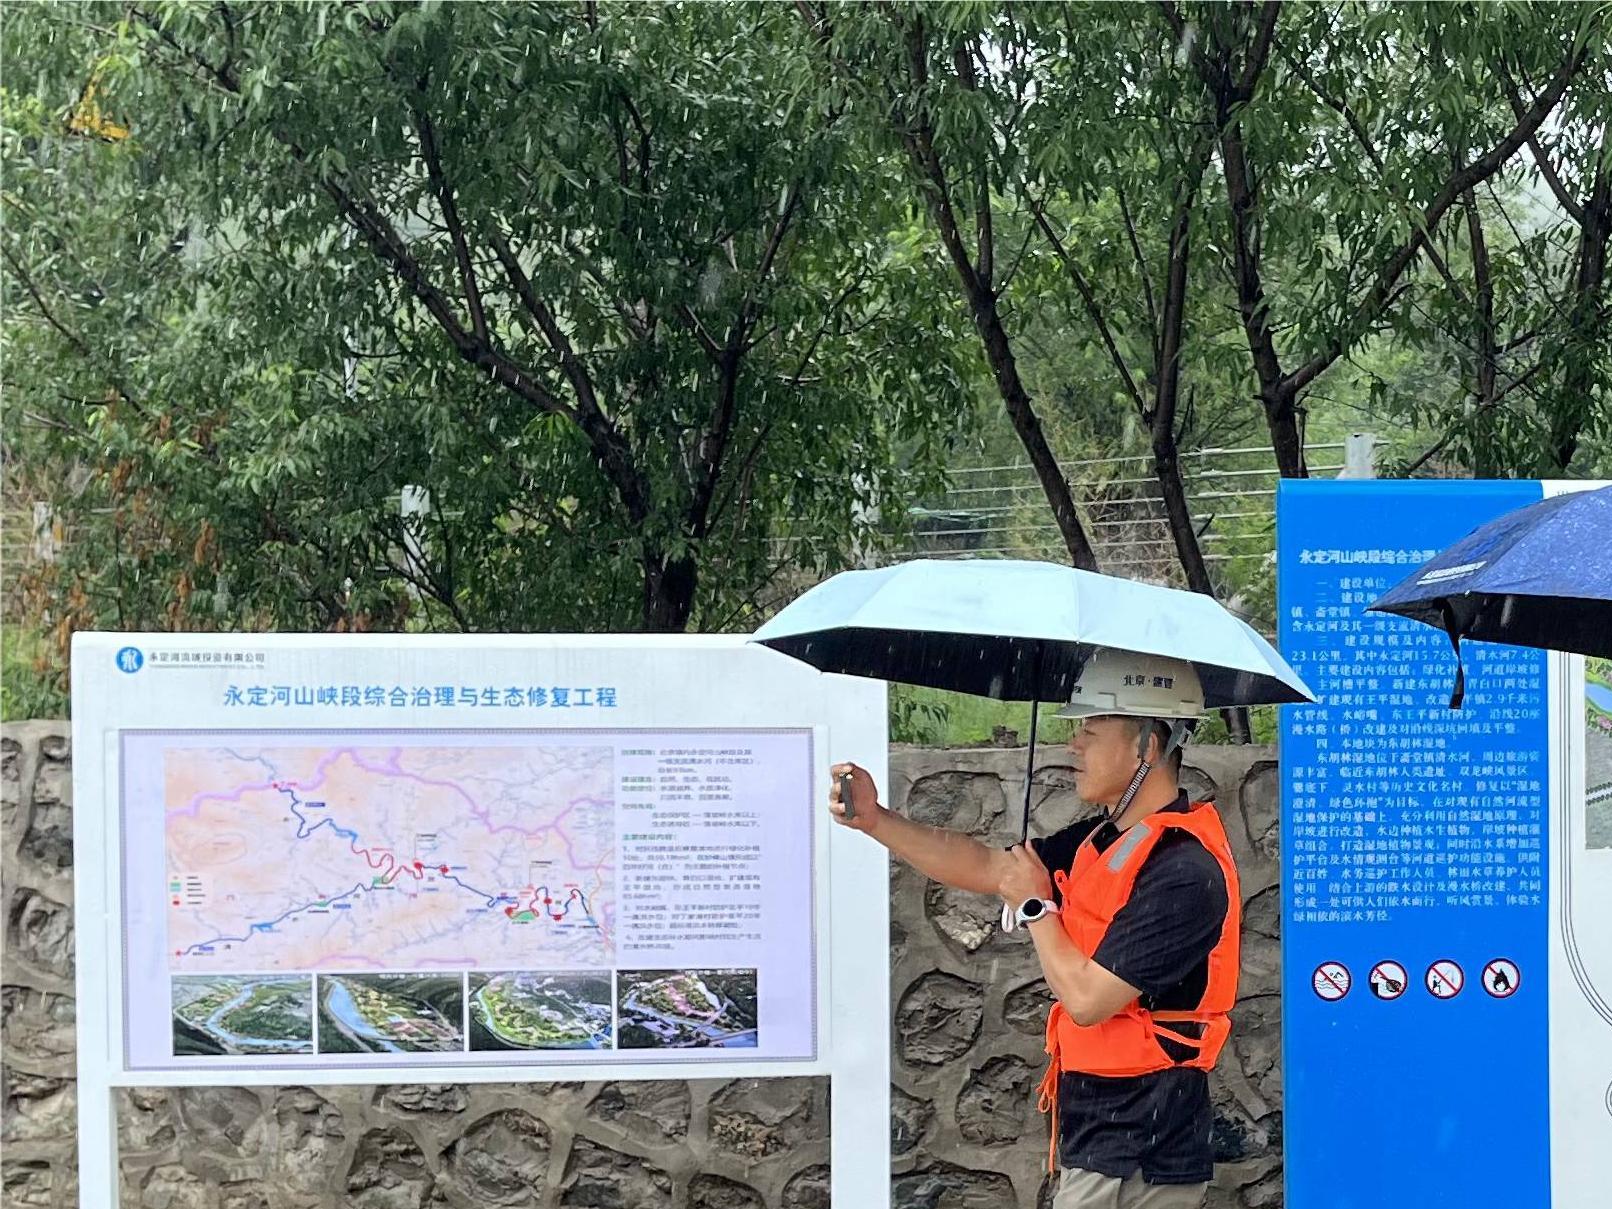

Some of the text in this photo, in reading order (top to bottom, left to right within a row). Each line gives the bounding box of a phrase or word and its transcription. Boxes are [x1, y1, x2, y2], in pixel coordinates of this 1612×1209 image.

[223, 685, 618, 708] 永定河山峡段综合治理与生态修复工程
